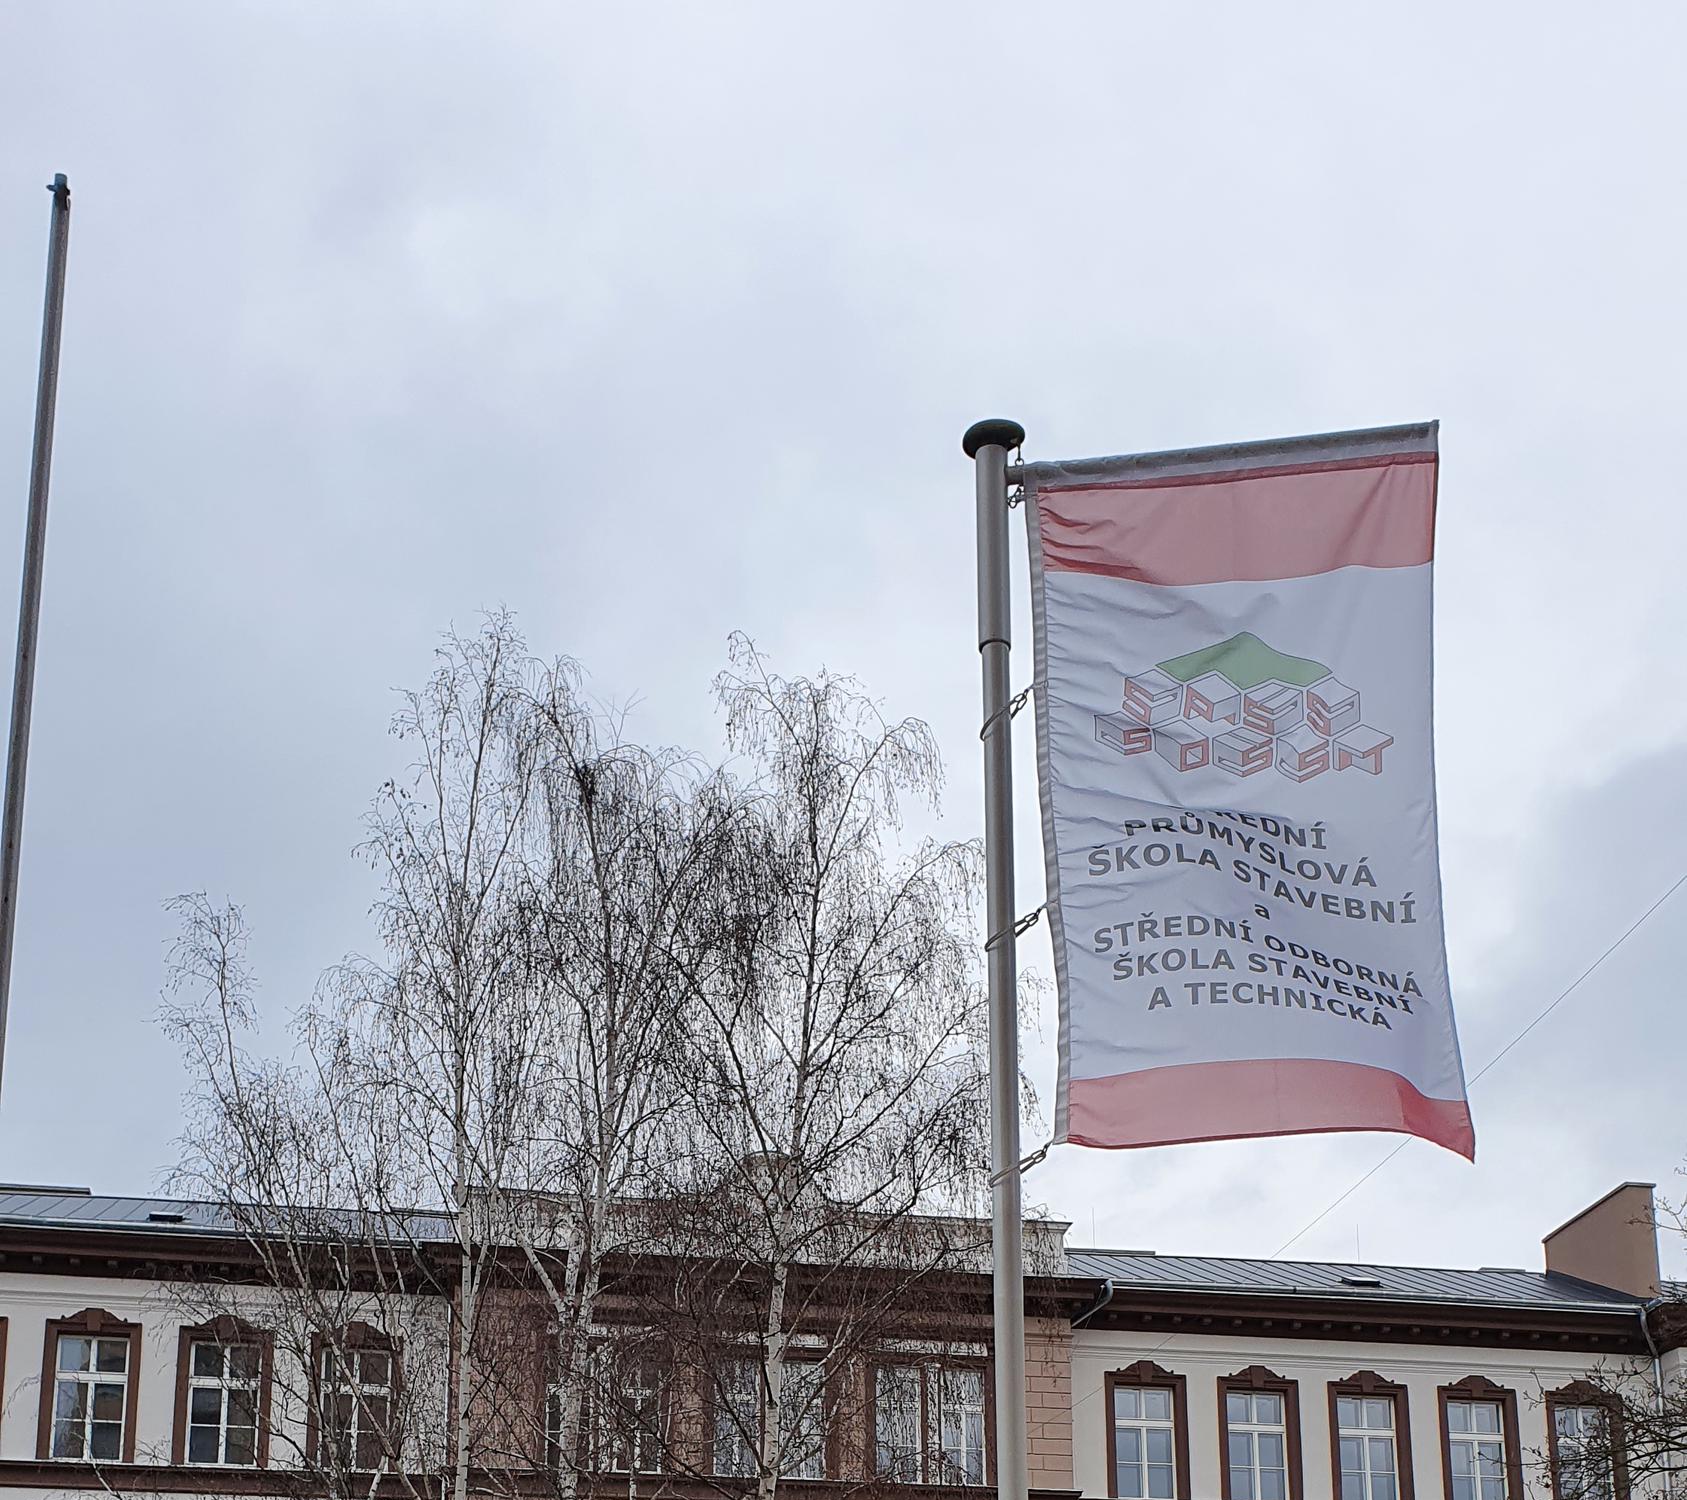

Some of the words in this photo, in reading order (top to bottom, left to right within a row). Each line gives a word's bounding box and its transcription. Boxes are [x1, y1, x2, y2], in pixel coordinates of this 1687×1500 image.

[1088, 844, 1222, 876] ŠKOLA
[1233, 859, 1417, 924] STAVEBNÍ
[1124, 811, 1378, 888] PRŮMYSLOVÁ
[1254, 903, 1271, 920] a
[1094, 911, 1254, 953] STŘEDNÍ
[1264, 934, 1423, 998] ODBORNÁ
[1113, 948, 1235, 981] ŠKOLA
[1248, 953, 1414, 1015] STAVEBNÍ
[1147, 986, 1173, 1011] A
[1183, 981, 1393, 1030] TECHNICKÁ
